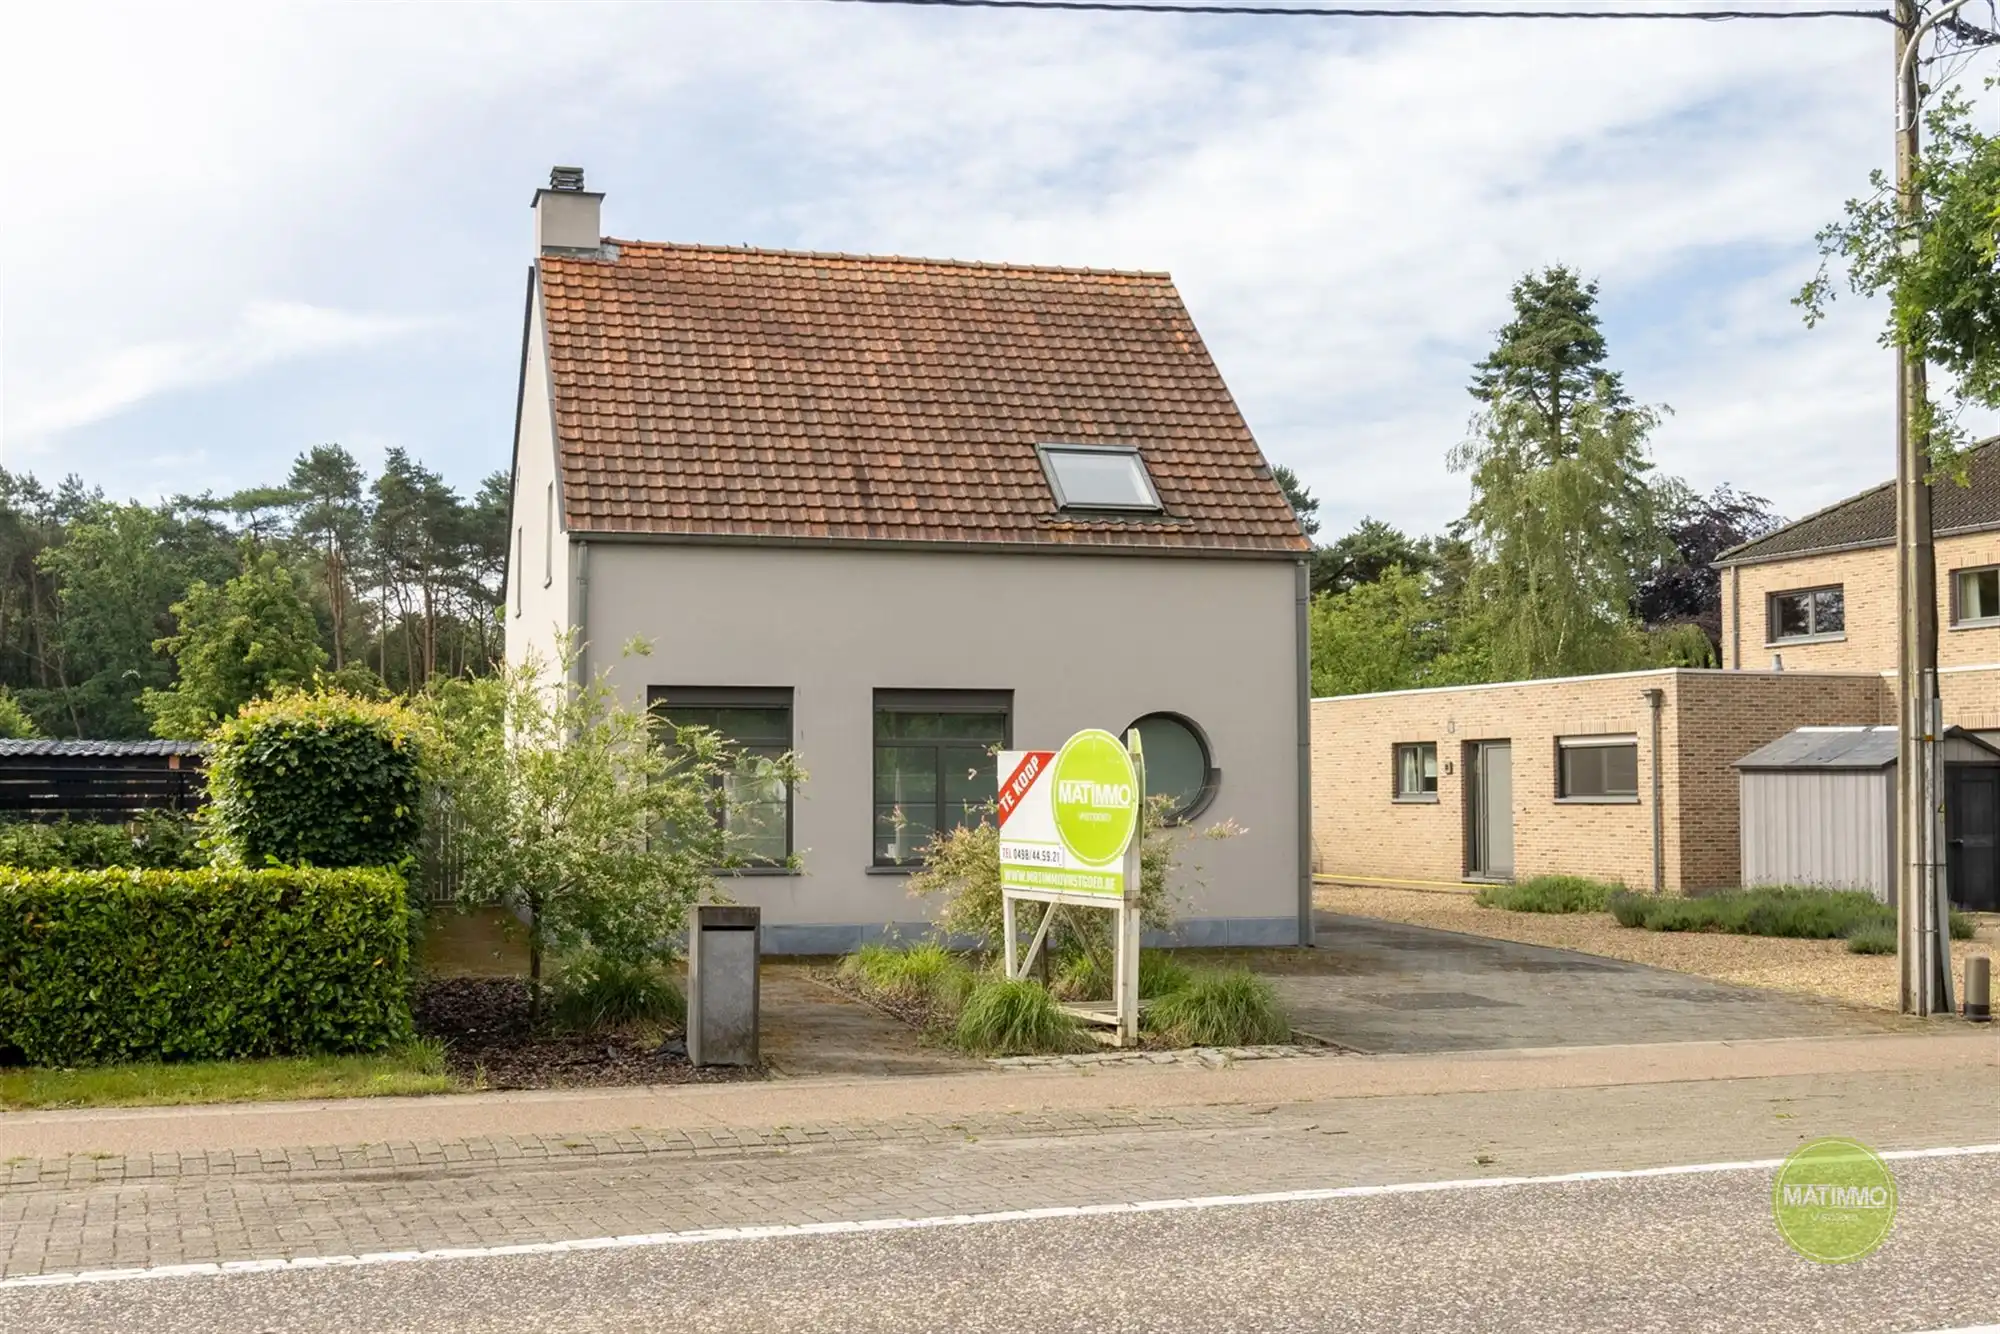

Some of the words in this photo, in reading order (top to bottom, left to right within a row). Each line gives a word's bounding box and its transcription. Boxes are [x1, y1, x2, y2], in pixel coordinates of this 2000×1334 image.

[1000, 791, 1014, 812] TE
[1012, 756, 1039, 796] KOOP
[1059, 780, 1131, 808] MATIMMO
